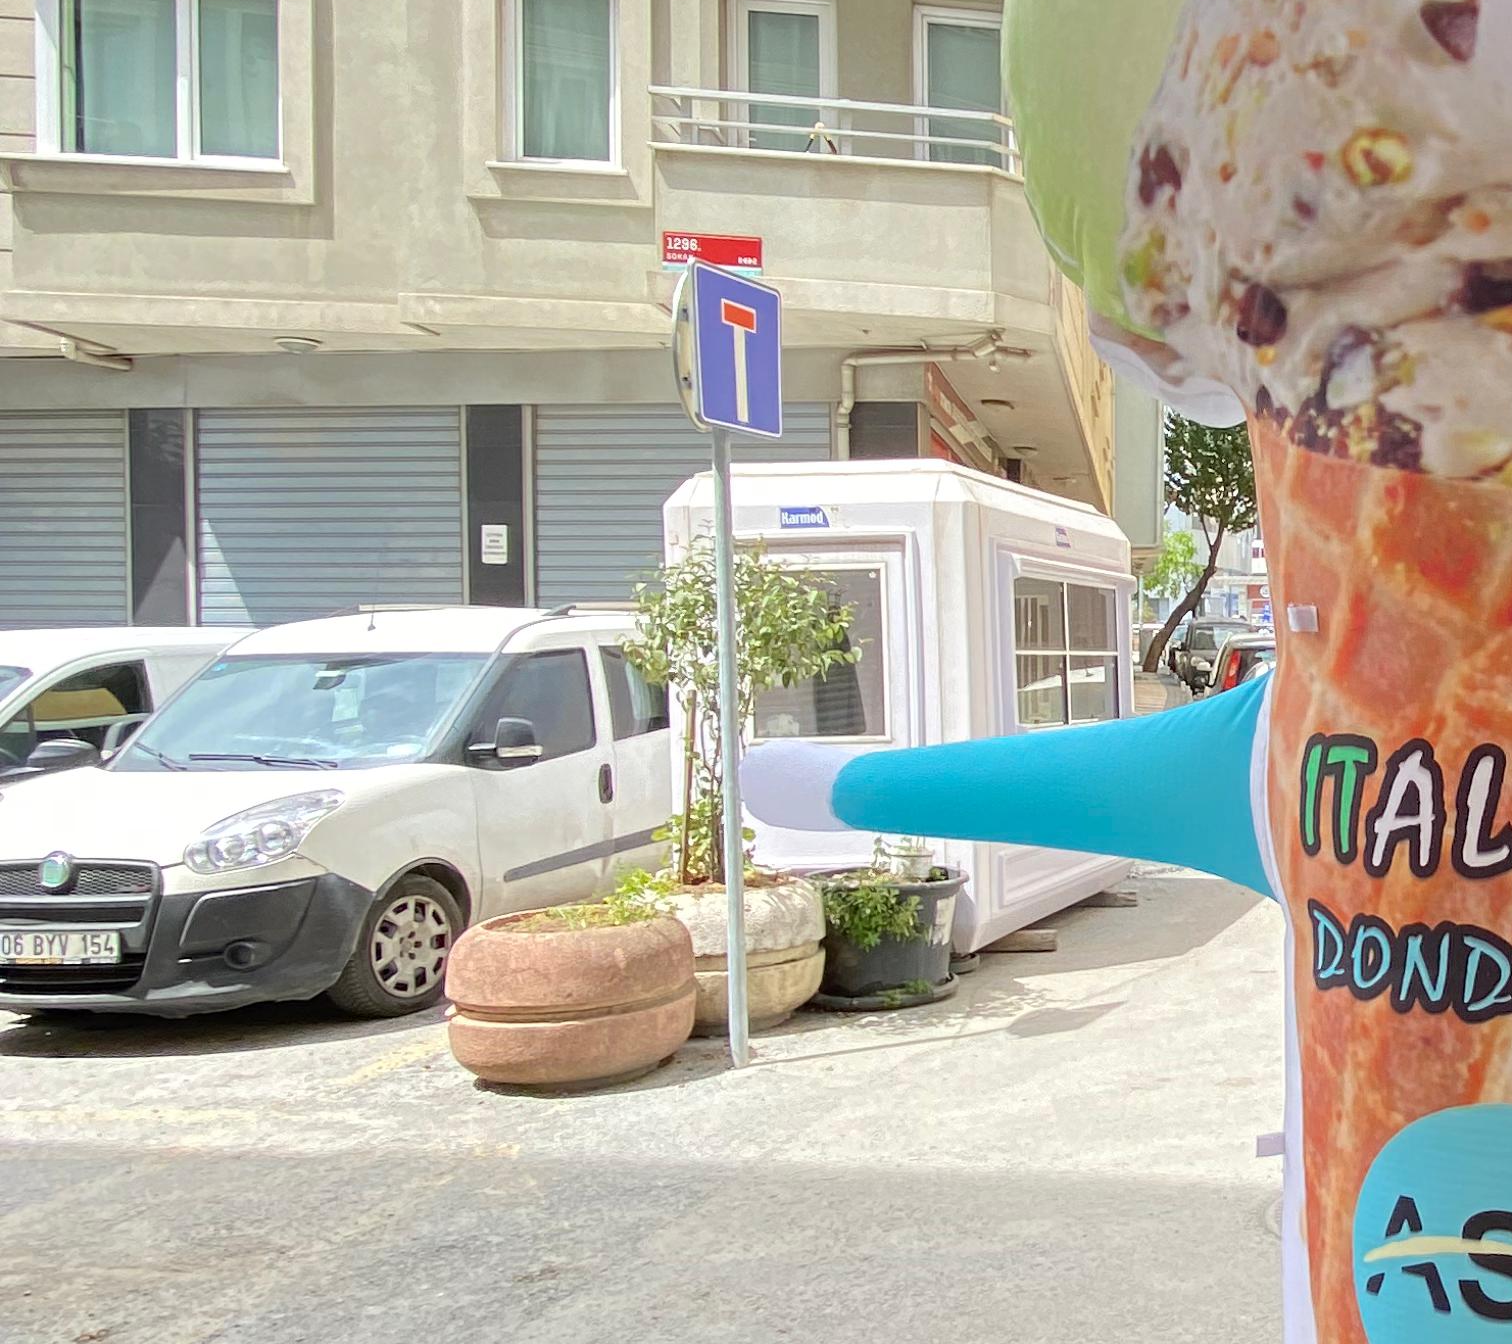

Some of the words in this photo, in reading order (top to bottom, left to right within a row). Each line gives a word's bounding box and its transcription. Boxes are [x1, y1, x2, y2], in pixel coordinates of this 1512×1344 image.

[781, 511, 824, 525] Karmod
[2, 935, 24, 955] 06
[33, 934, 69, 956] BYV
[81, 934, 114, 955] 154
